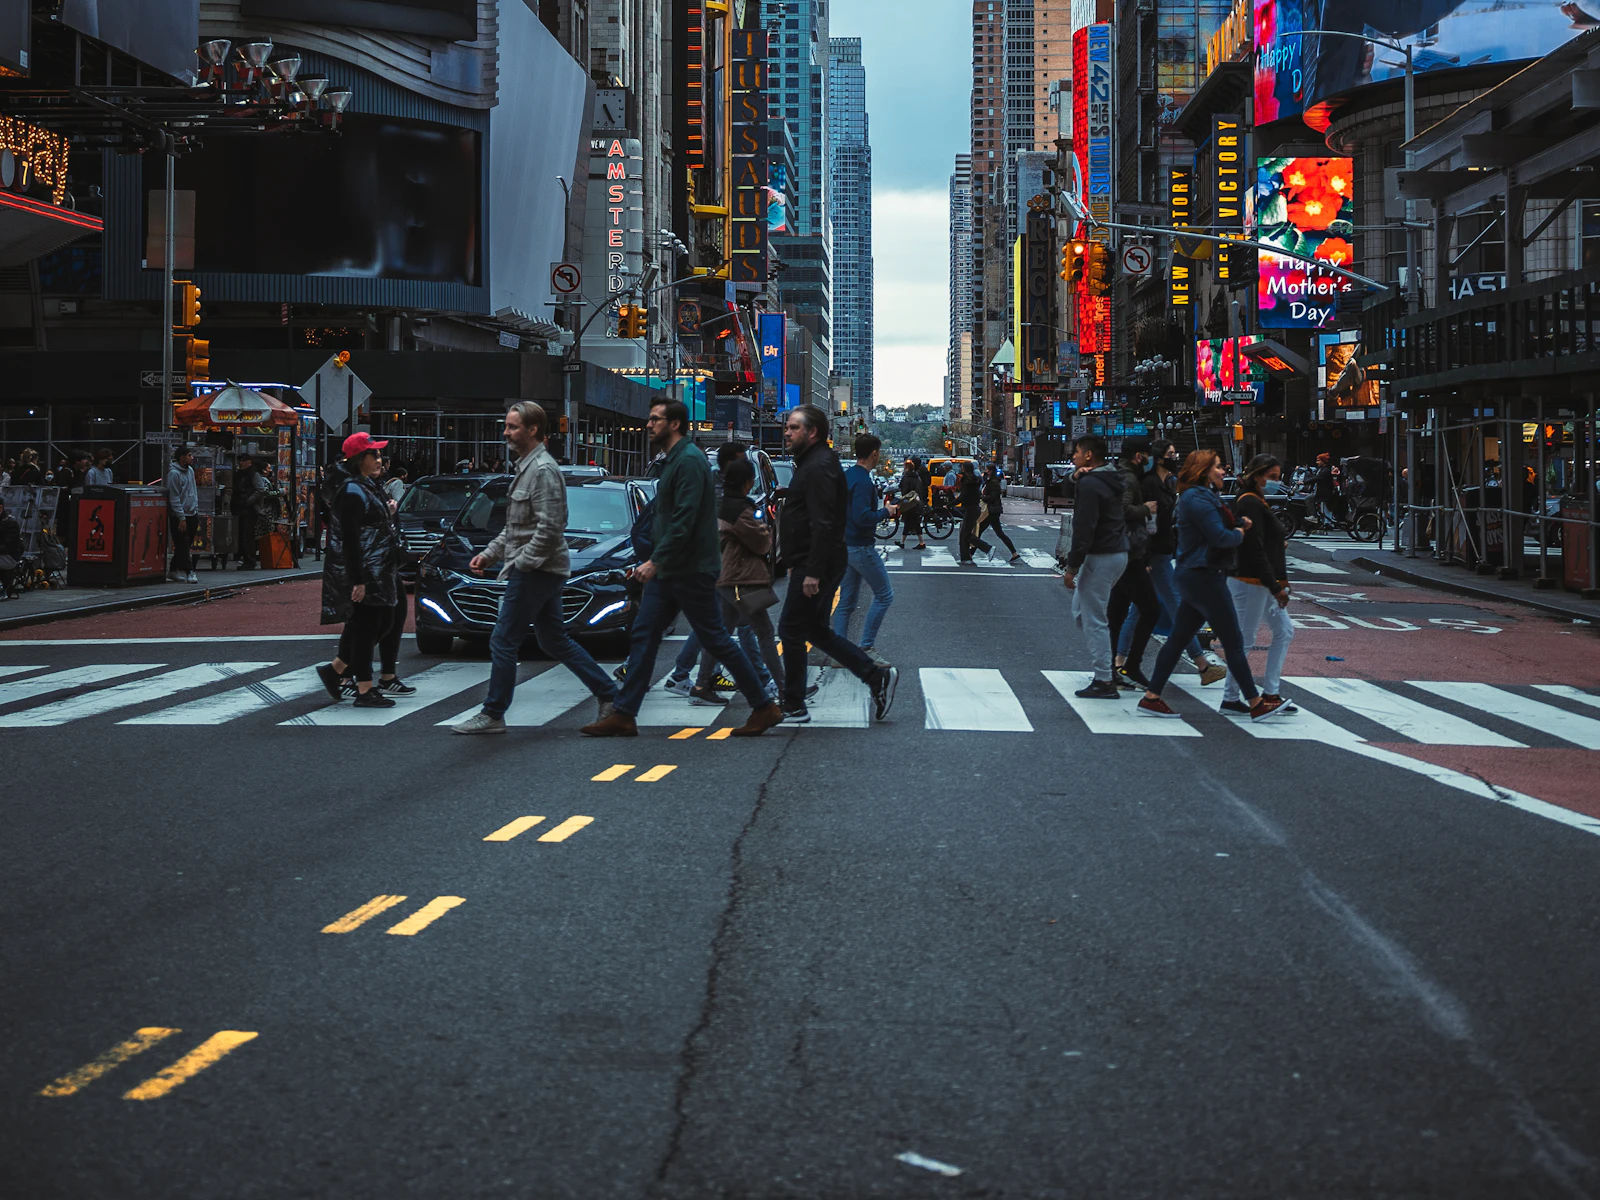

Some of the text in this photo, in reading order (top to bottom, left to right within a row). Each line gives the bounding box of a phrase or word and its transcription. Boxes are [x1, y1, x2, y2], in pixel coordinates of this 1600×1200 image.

[1089, 26, 1110, 62] NEW
[1260, 43, 1297, 73] Happy
[739, 31, 761, 282] TUSSAUDS
[1090, 125, 1111, 195] STUDIOS
[1218, 120, 1238, 218] VICTORY
[22, 161, 29, 186] 7
[1029, 218, 1048, 351] REGAL
[1172, 265, 1189, 305] NEW
[1266, 276, 1352, 295] Mother's
[1289, 301, 1331, 327] Day
[763, 345, 779, 357] EAT
[1074, 425, 1086, 433] 25
[1487, 528, 1505, 545] OYS
[1288, 613, 1504, 634] BUS
